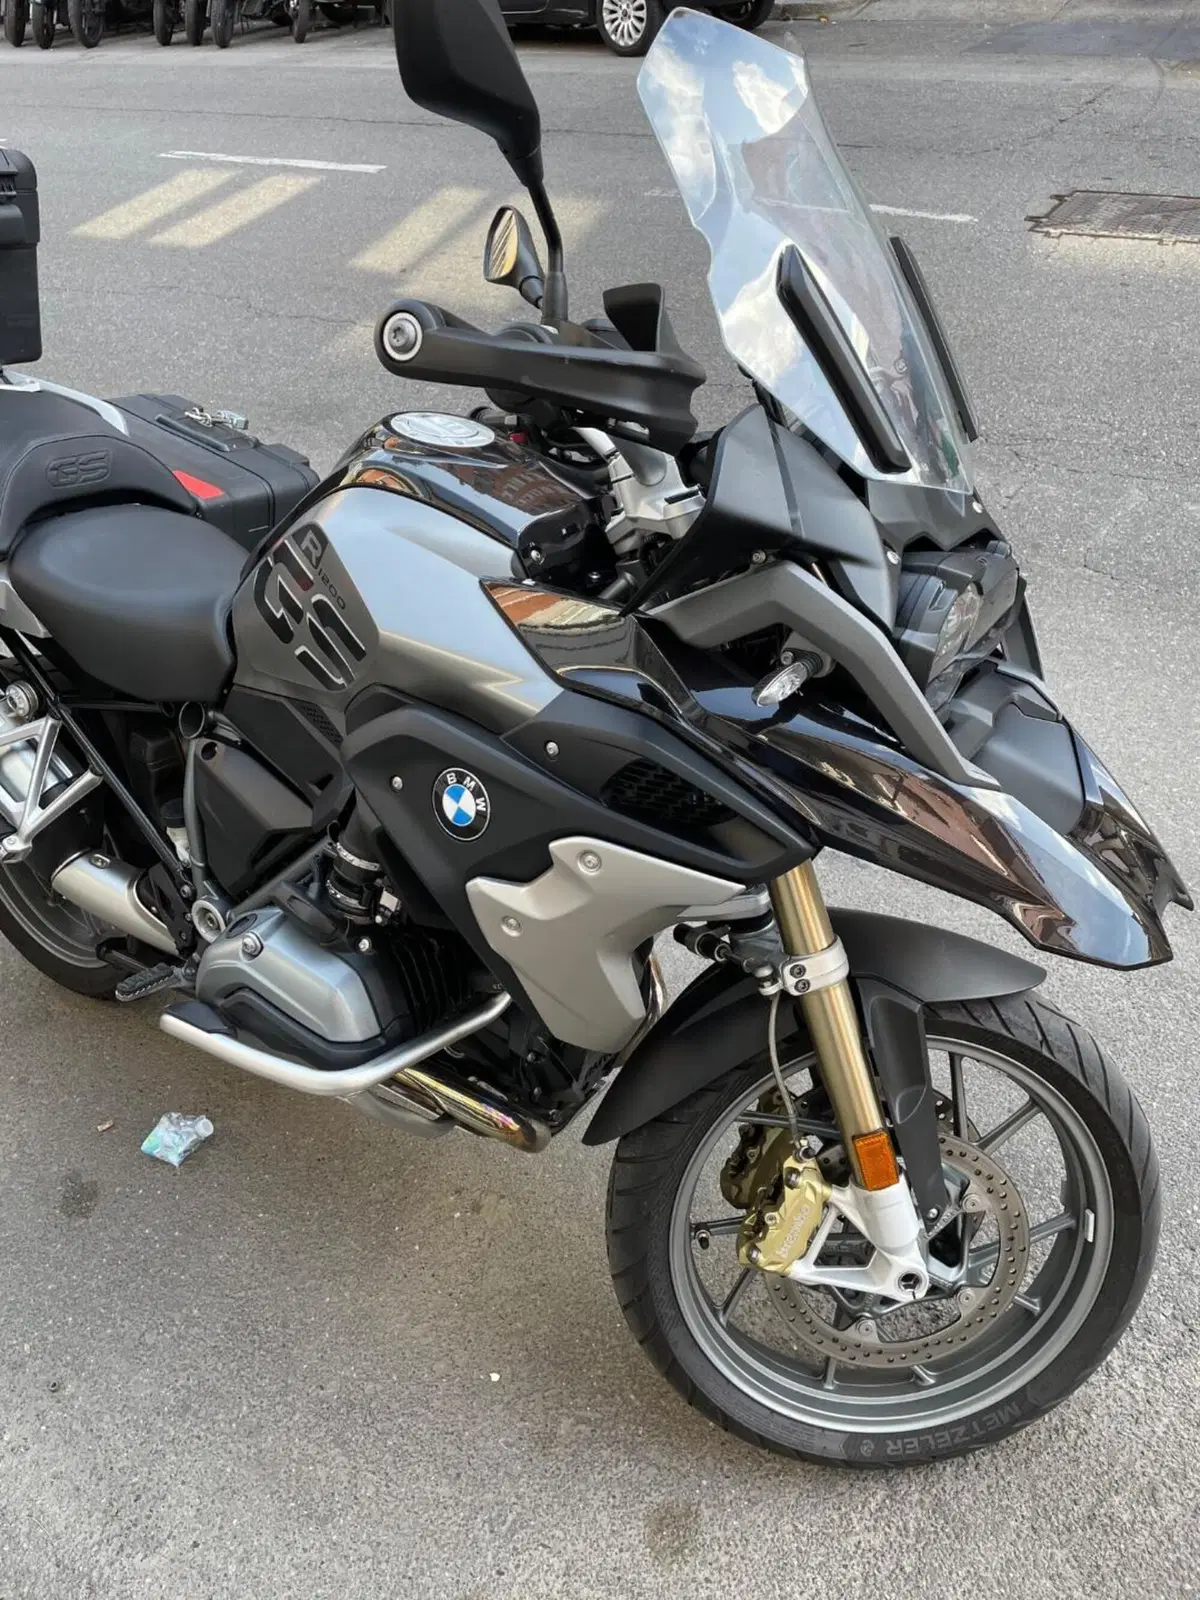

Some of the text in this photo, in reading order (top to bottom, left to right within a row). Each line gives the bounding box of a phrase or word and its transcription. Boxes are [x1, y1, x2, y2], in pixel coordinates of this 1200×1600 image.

[45, 450, 110, 488] GS
[300, 529, 347, 611] R 1200
[253, 539, 367, 692] GS
[446, 772, 487, 812] BMW
[885, 1402, 1022, 1457] METZELER
